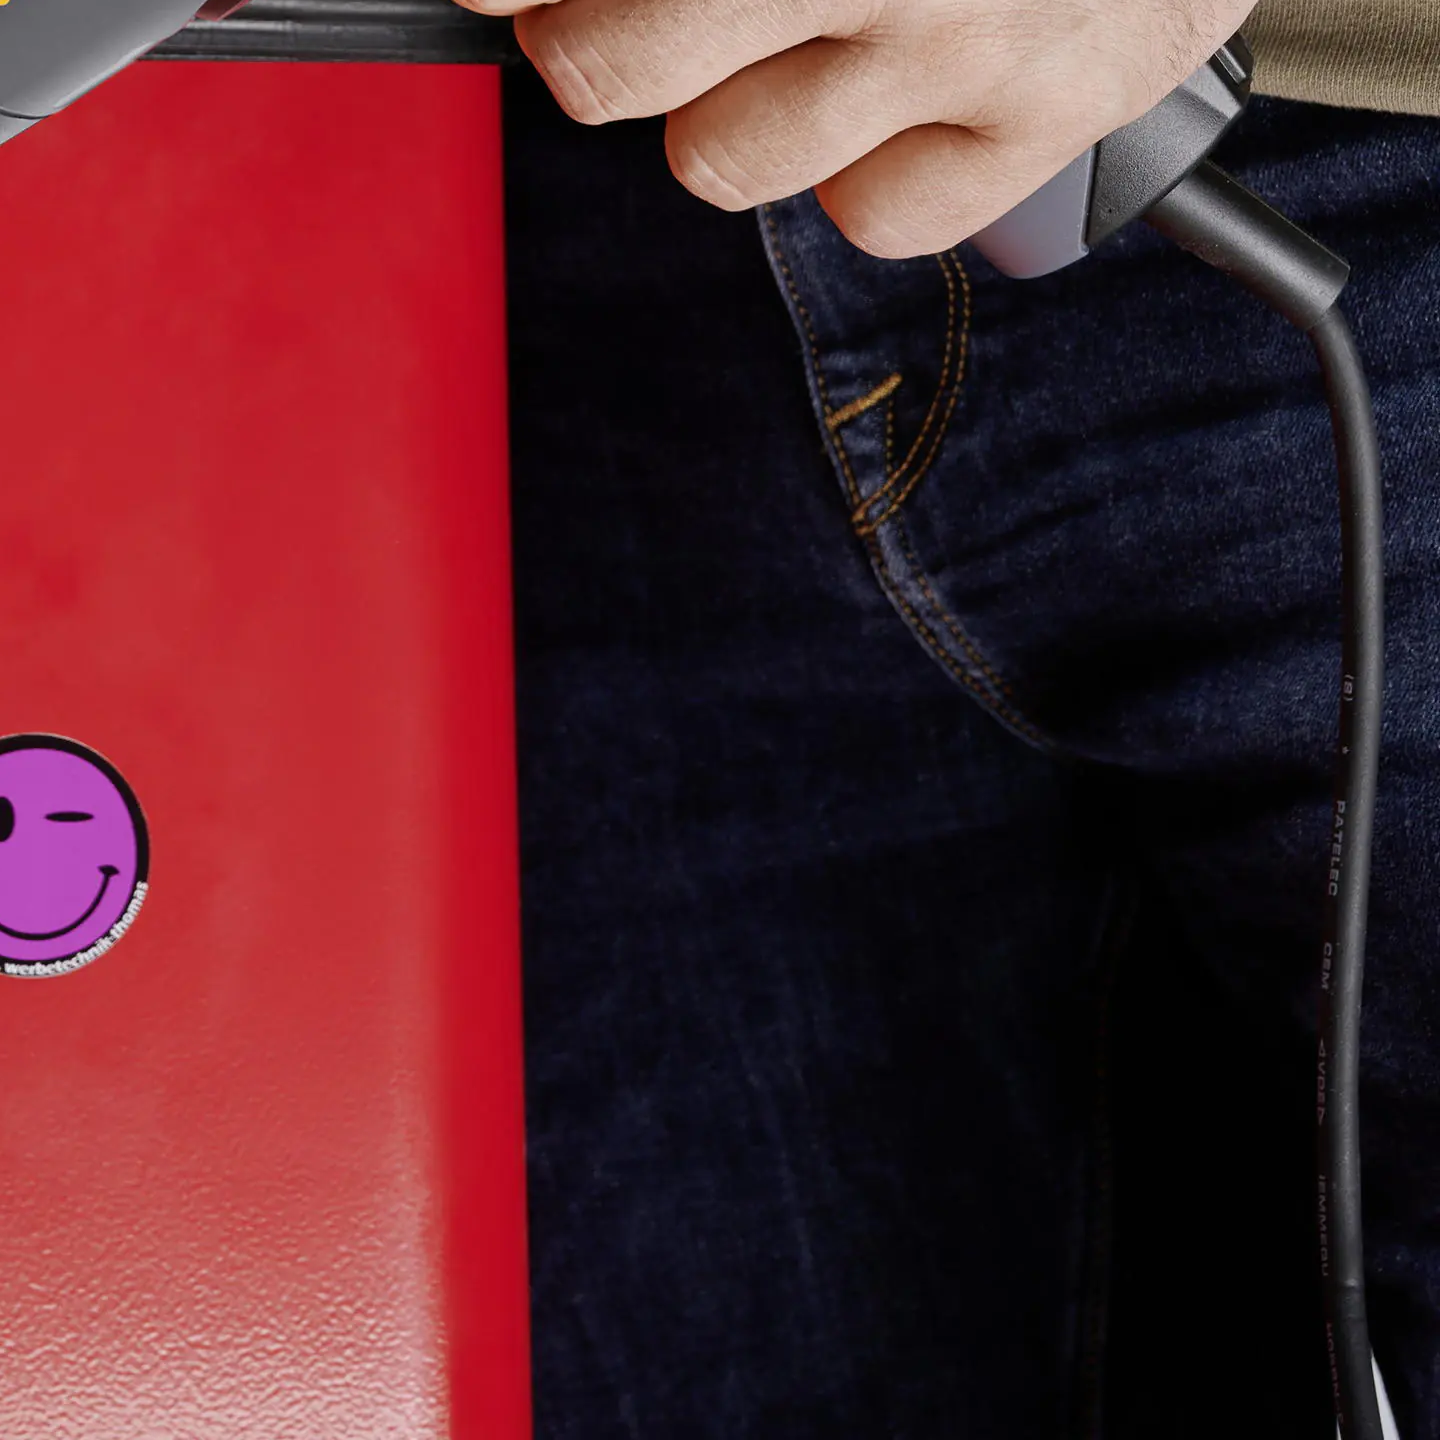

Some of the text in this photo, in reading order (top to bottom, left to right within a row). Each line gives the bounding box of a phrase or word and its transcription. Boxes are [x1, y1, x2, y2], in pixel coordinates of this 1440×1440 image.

[1327, 800, 1346, 898] PATELEC
[3, 881, 150, 977] werbetechnik-thomas
[1320, 942, 1334, 991] CEM
